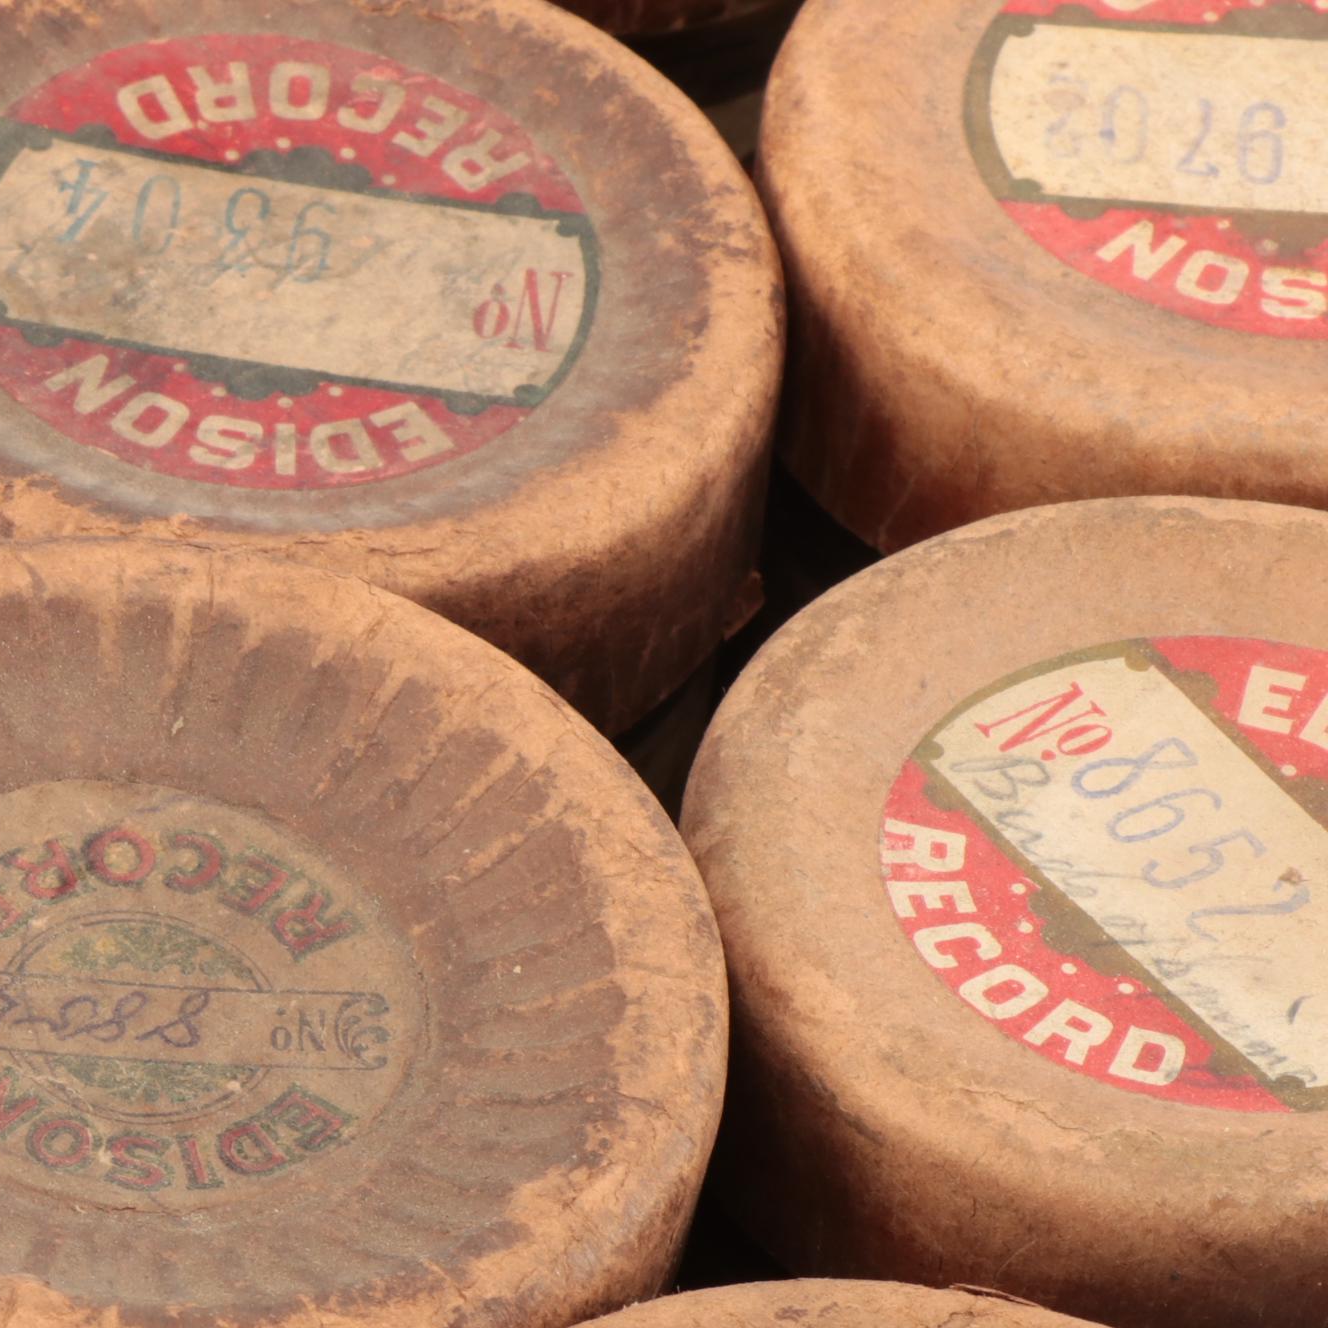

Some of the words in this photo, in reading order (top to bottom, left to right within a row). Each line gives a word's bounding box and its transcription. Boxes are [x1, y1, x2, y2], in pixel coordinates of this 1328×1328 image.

[117, 60, 531, 194] RECORD
[43, 353, 455, 478] EDISON
[881, 818, 1187, 1086] RECORD
